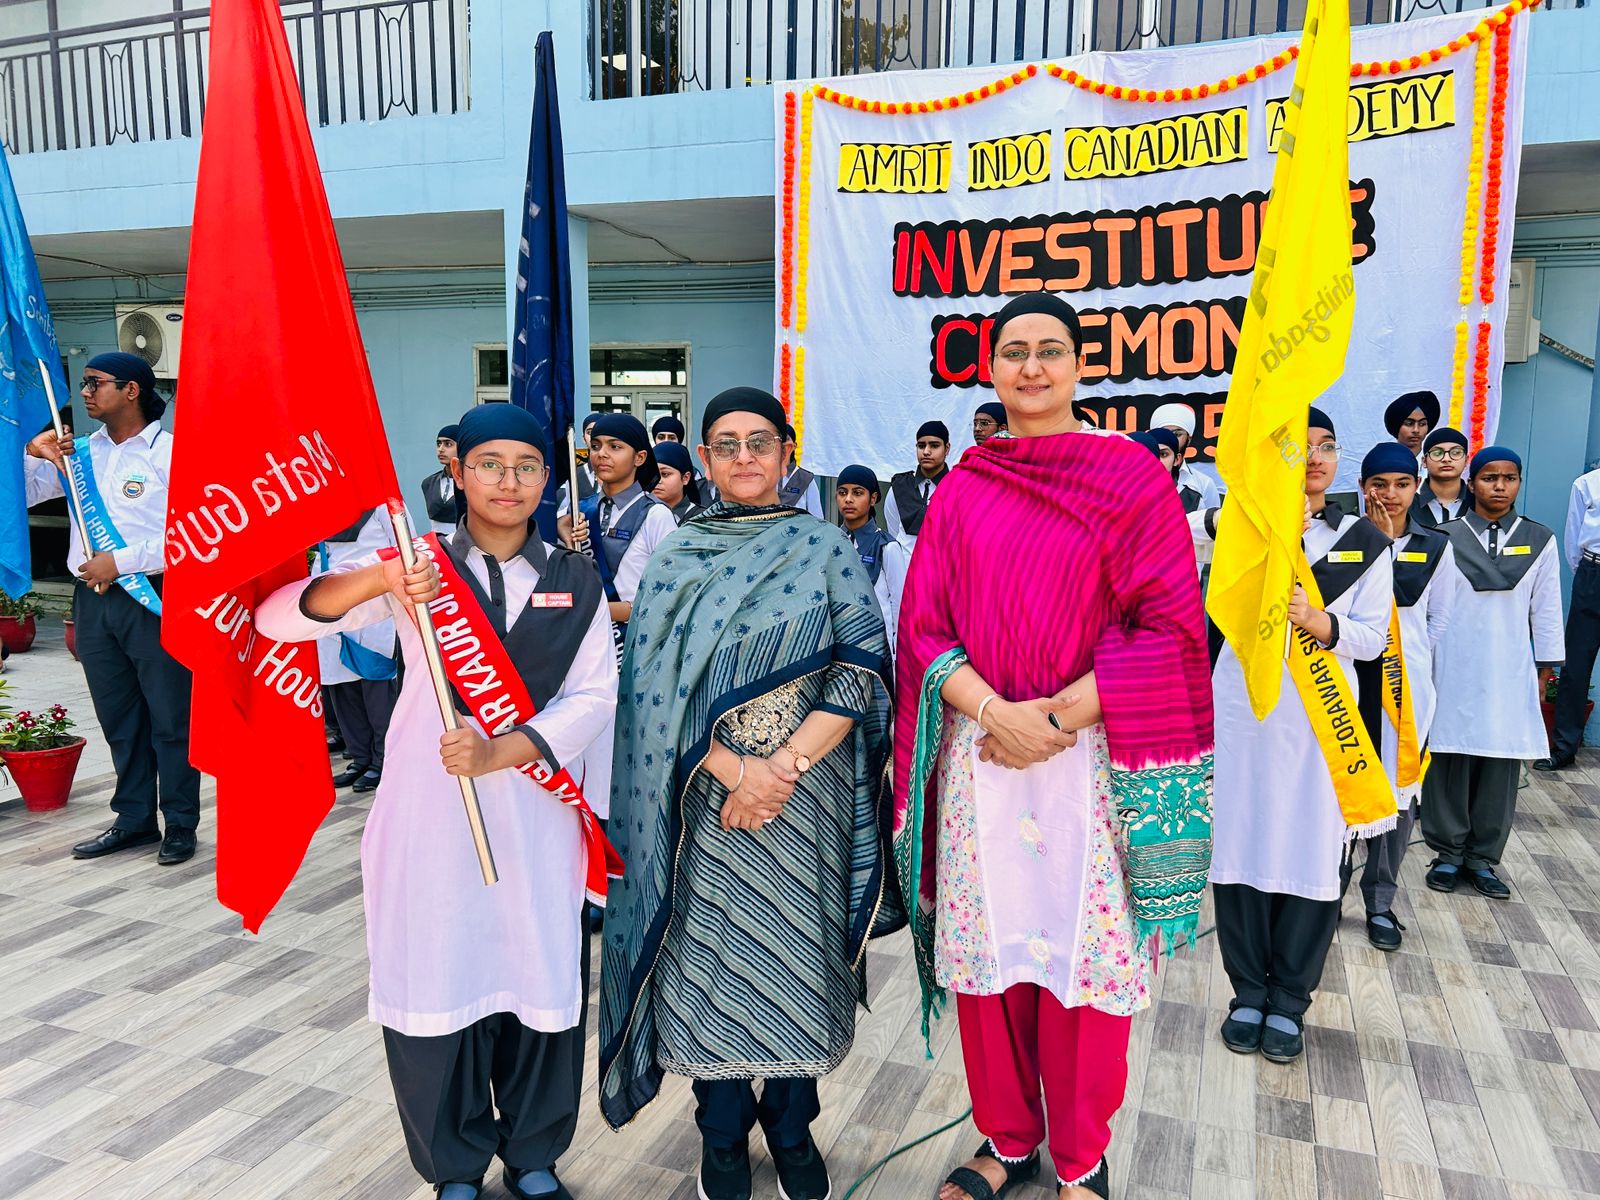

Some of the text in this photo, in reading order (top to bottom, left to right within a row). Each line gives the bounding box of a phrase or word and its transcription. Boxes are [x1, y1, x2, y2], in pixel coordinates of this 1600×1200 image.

[849, 78, 1447, 187] AMRIT INDO CANADIAN ADEMY
[893, 187, 1369, 294] INVESTITU
[86, 515, 117, 552] INGH
[253, 641, 323, 718] Hous
[436, 616, 503, 698] KAUR
[1309, 656, 1360, 754] ZORAWAR
[1347, 752, 1368, 775] S.
